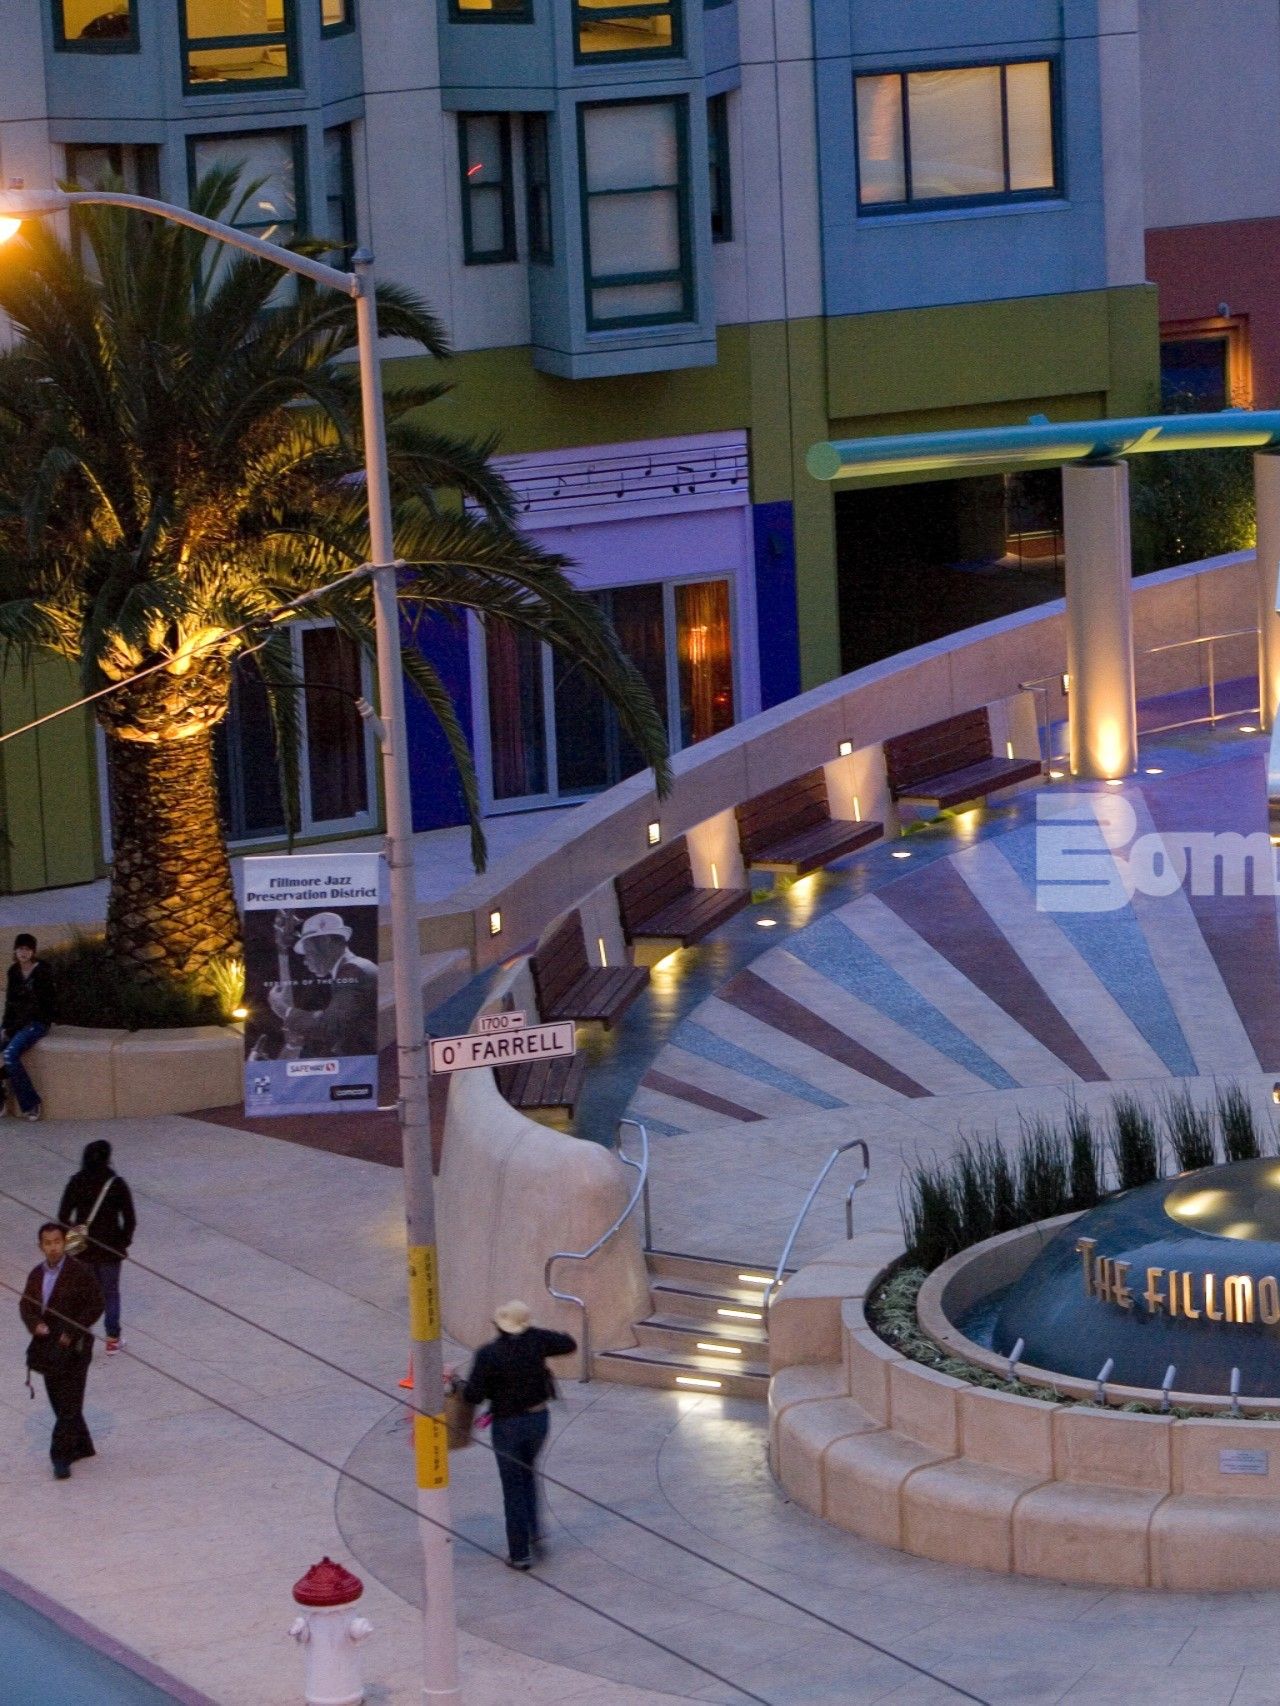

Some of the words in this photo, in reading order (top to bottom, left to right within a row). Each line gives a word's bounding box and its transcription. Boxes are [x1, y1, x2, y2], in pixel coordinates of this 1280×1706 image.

[269, 877, 322, 888] Fillmore
[324, 875, 352, 886] Jazz
[246, 889, 328, 902] Preservation
[330, 887, 377, 899] District
[481, 1016, 509, 1030] 1700
[471, 1032, 564, 1061] FARRELL
[1075, 1237, 1134, 1309] THE
